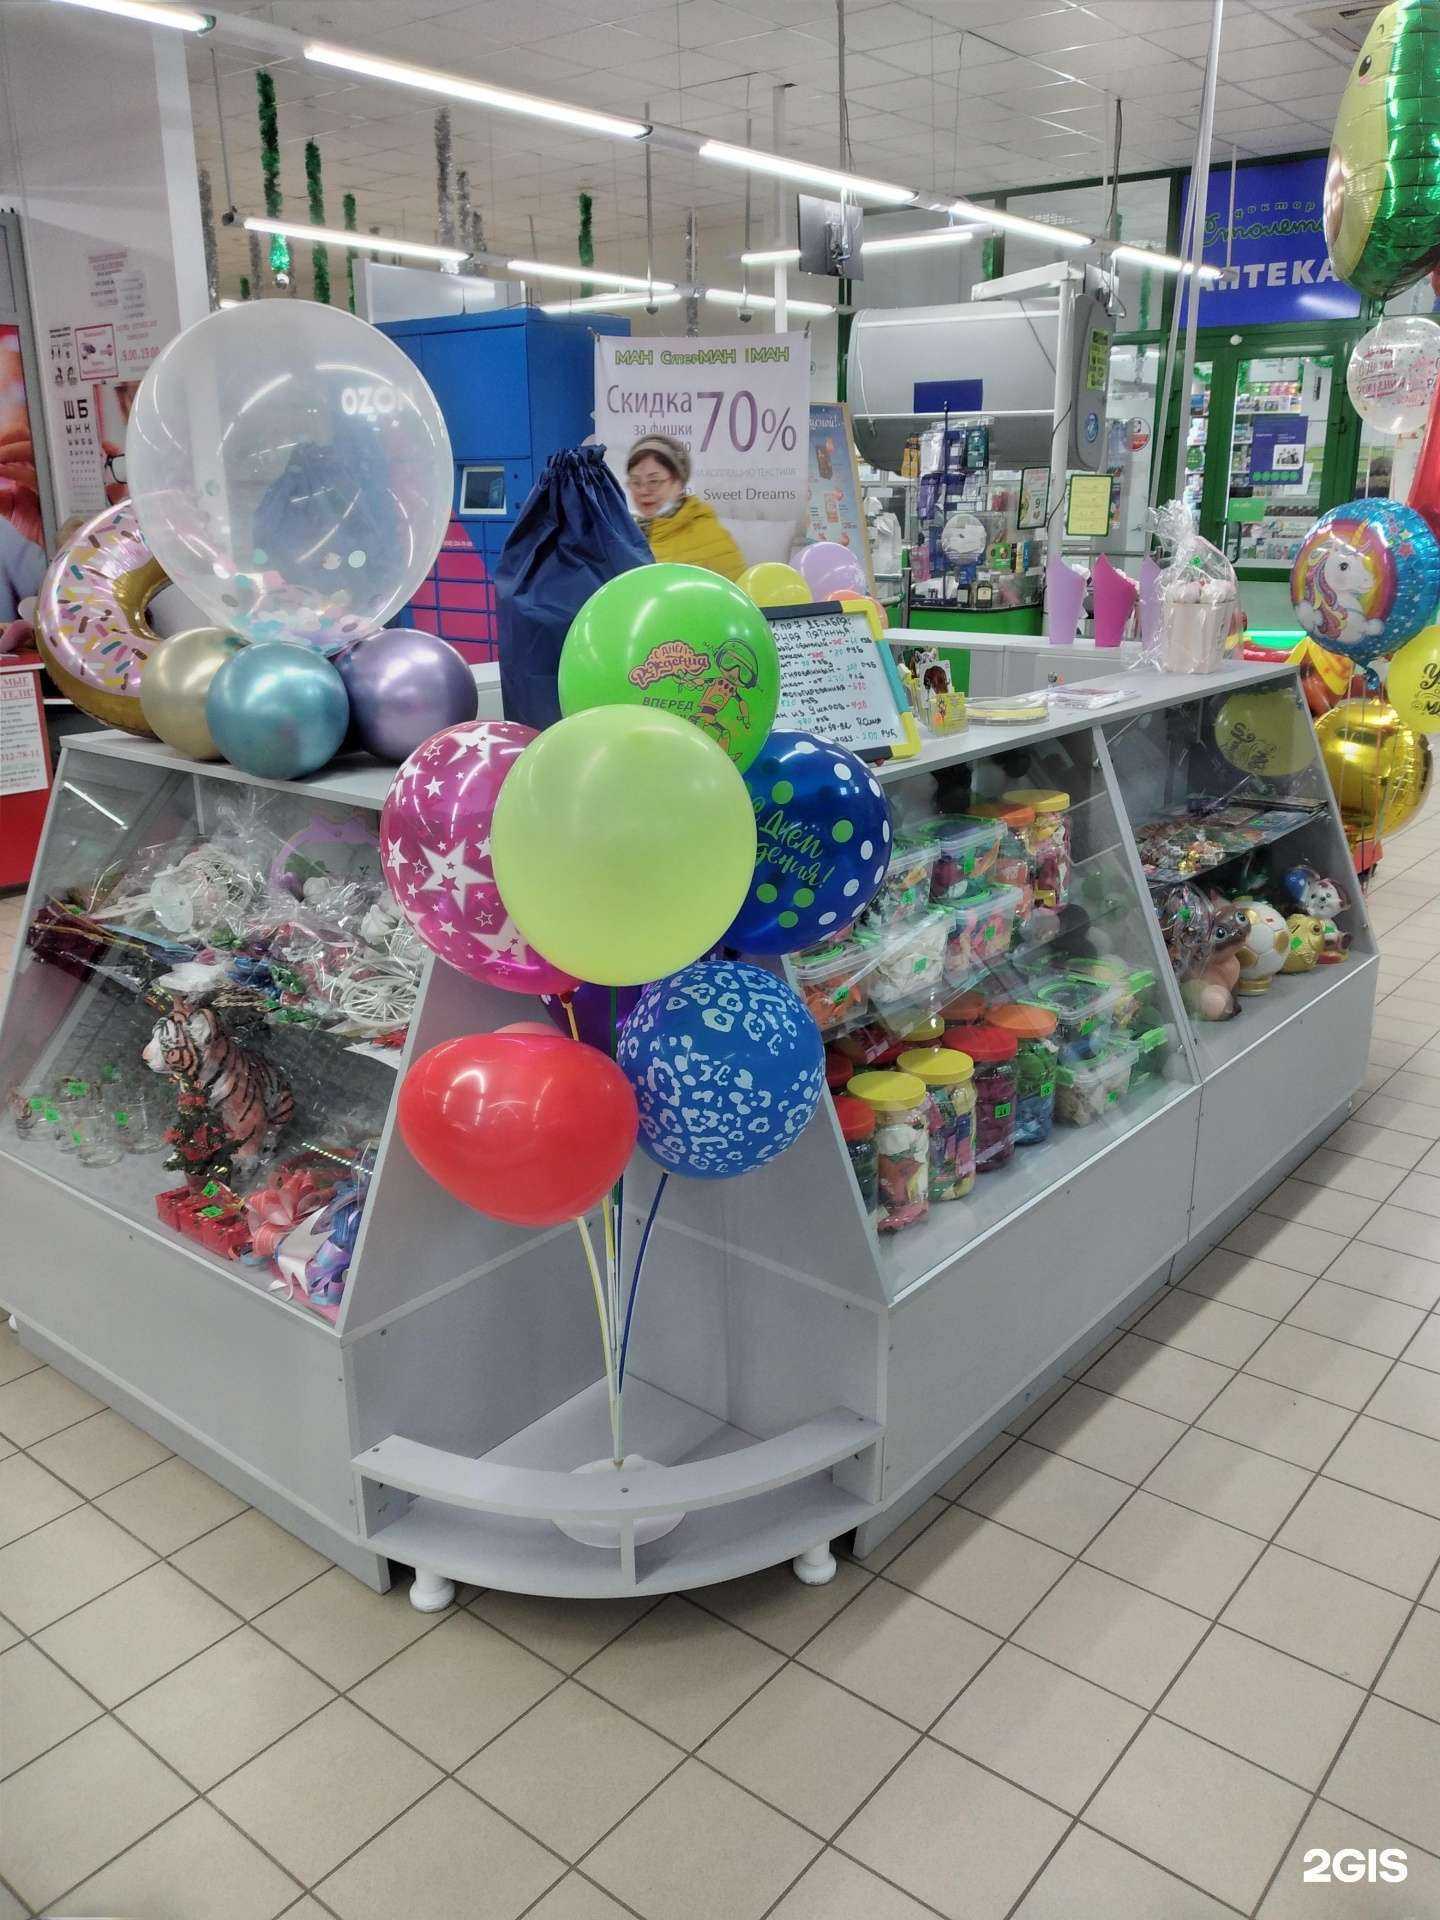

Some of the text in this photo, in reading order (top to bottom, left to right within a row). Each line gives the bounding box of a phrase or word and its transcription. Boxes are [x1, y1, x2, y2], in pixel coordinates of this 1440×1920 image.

[607, 385, 797, 452] Скидка 70%
[633, 427, 646, 436] за
[703, 488, 741, 500] Sweet
[746, 487, 796, 500] Dreams
